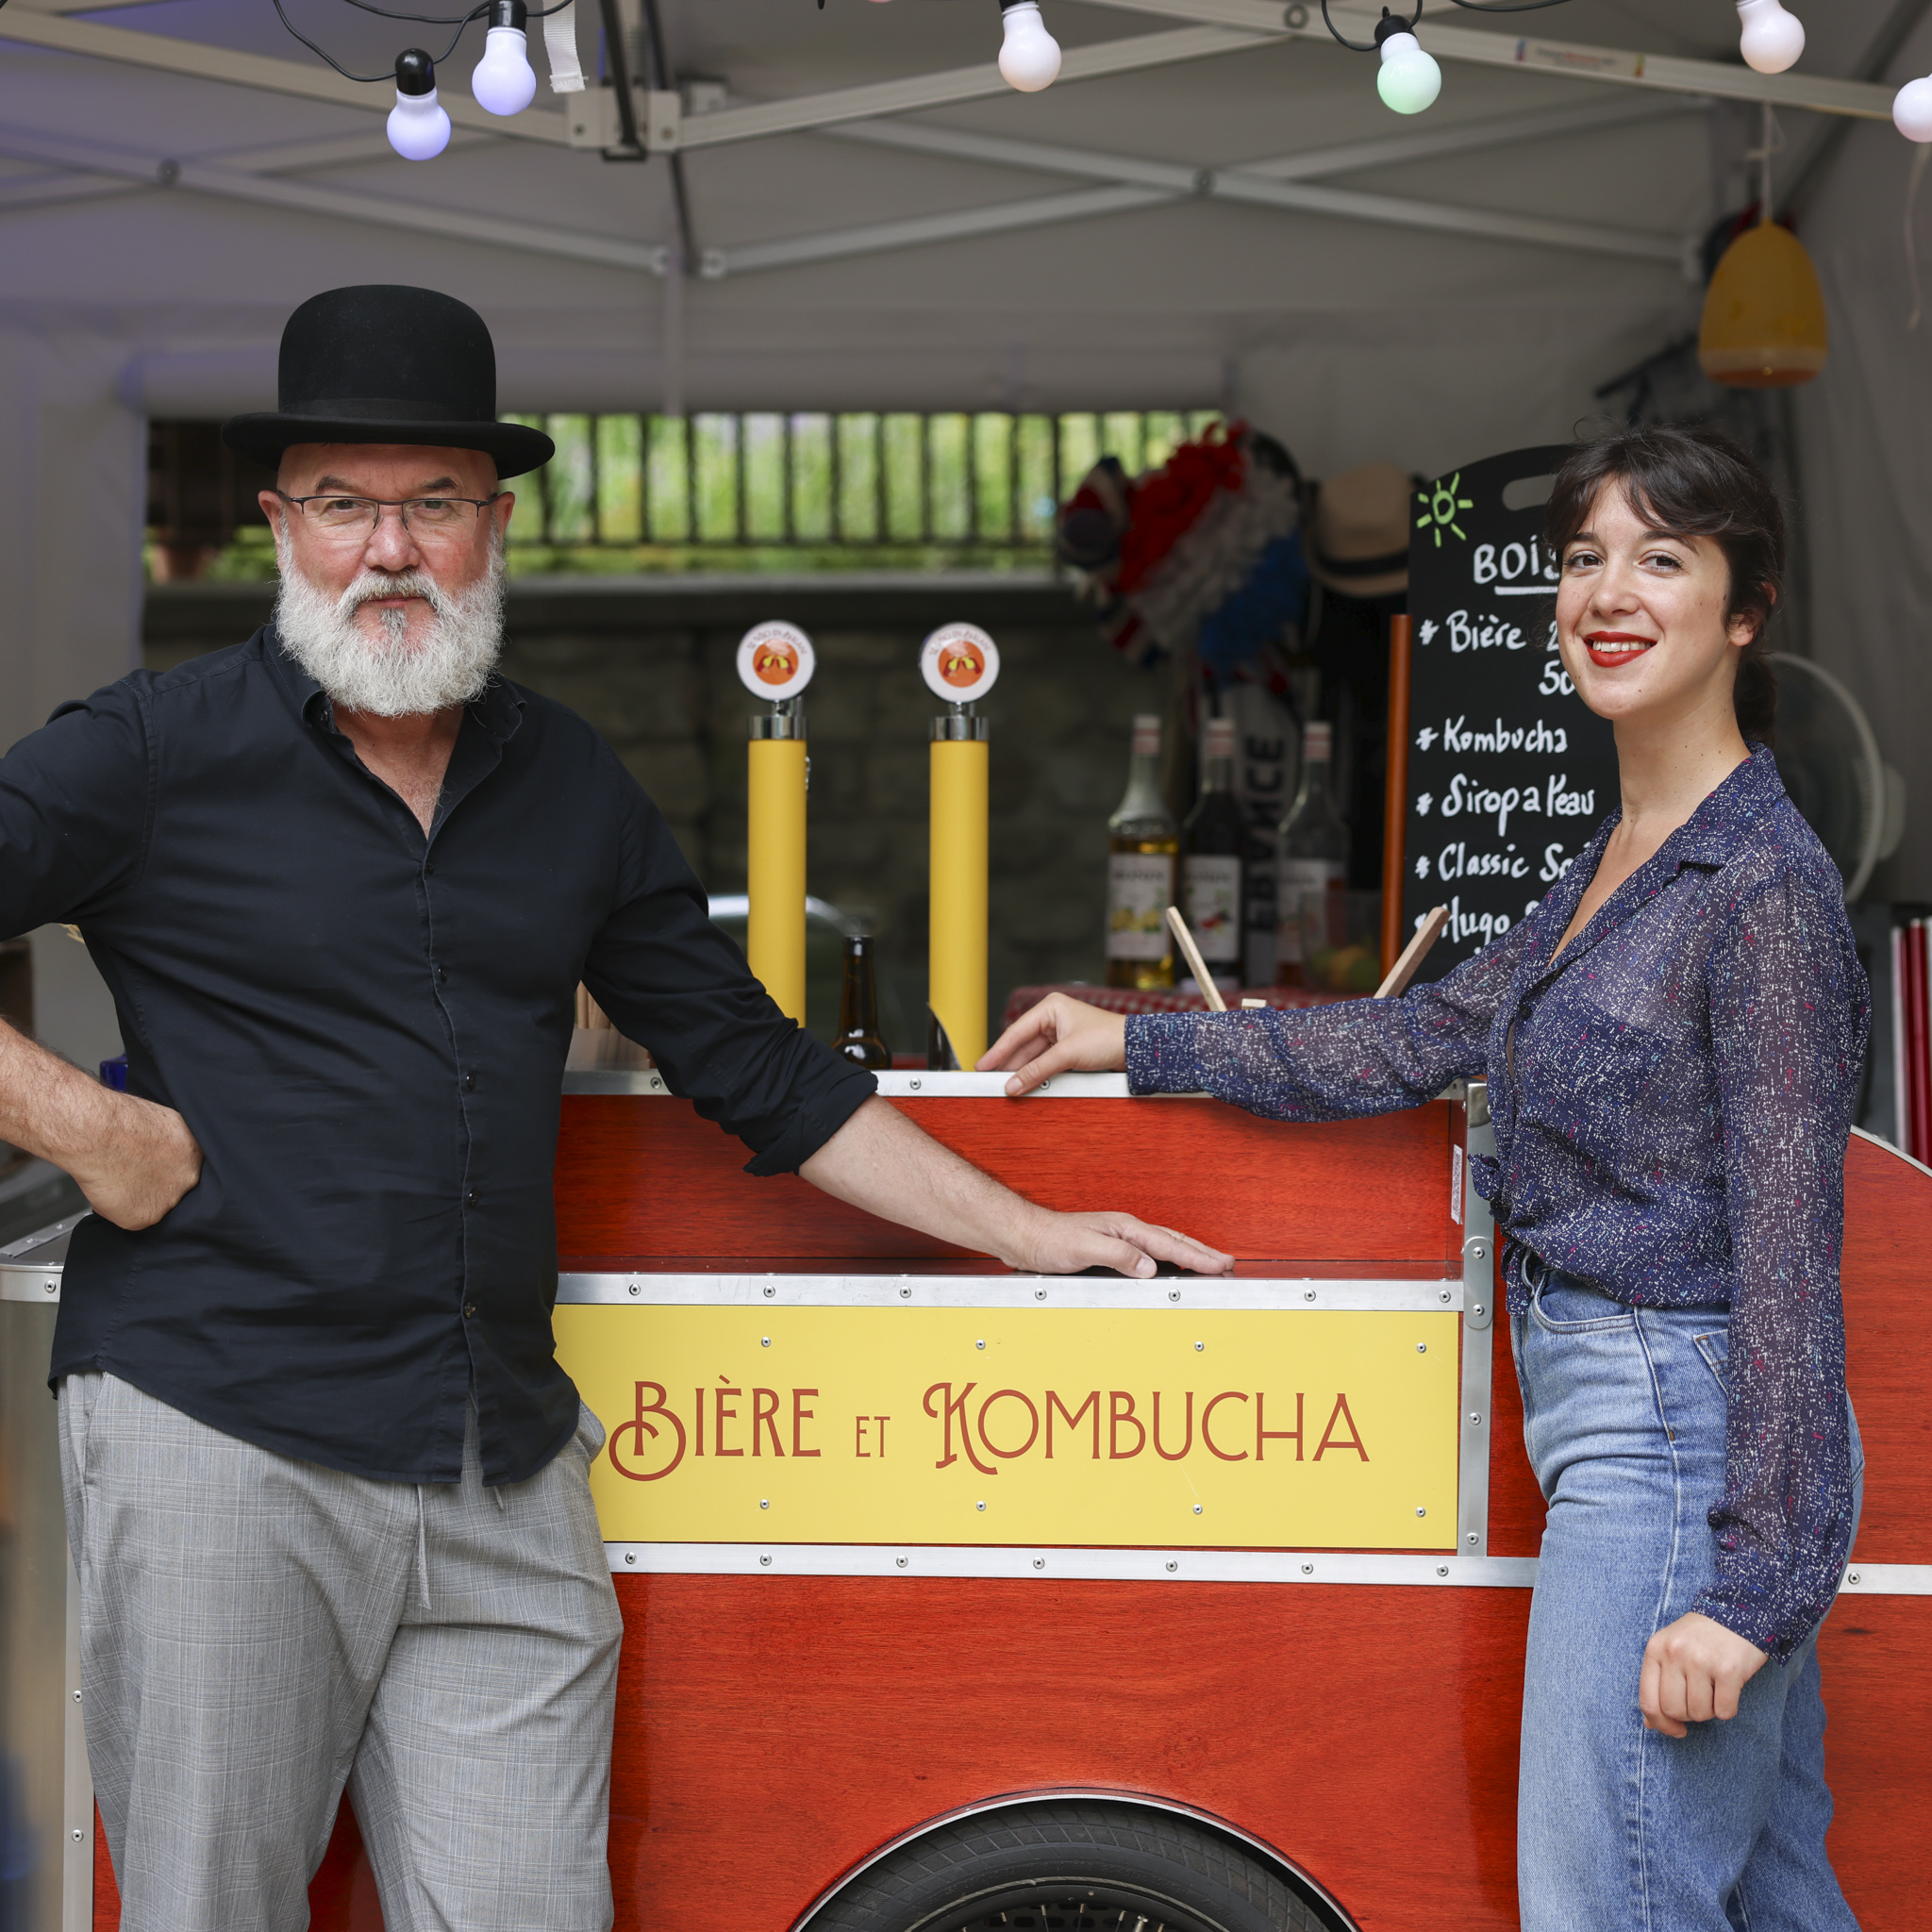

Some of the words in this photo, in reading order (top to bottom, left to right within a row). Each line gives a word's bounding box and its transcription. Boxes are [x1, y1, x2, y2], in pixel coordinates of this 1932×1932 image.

[1445, 609, 1527, 653] Bière
[1443, 714, 1568, 753] Kombucha
[1441, 773, 1519, 837] Sirop
[1438, 841, 1529, 881] Classic
[608, 1374, 822, 1482] BIÈRE
[856, 1416, 891, 1458] ET
[923, 1382, 1371, 1475] KOMBUCHA
